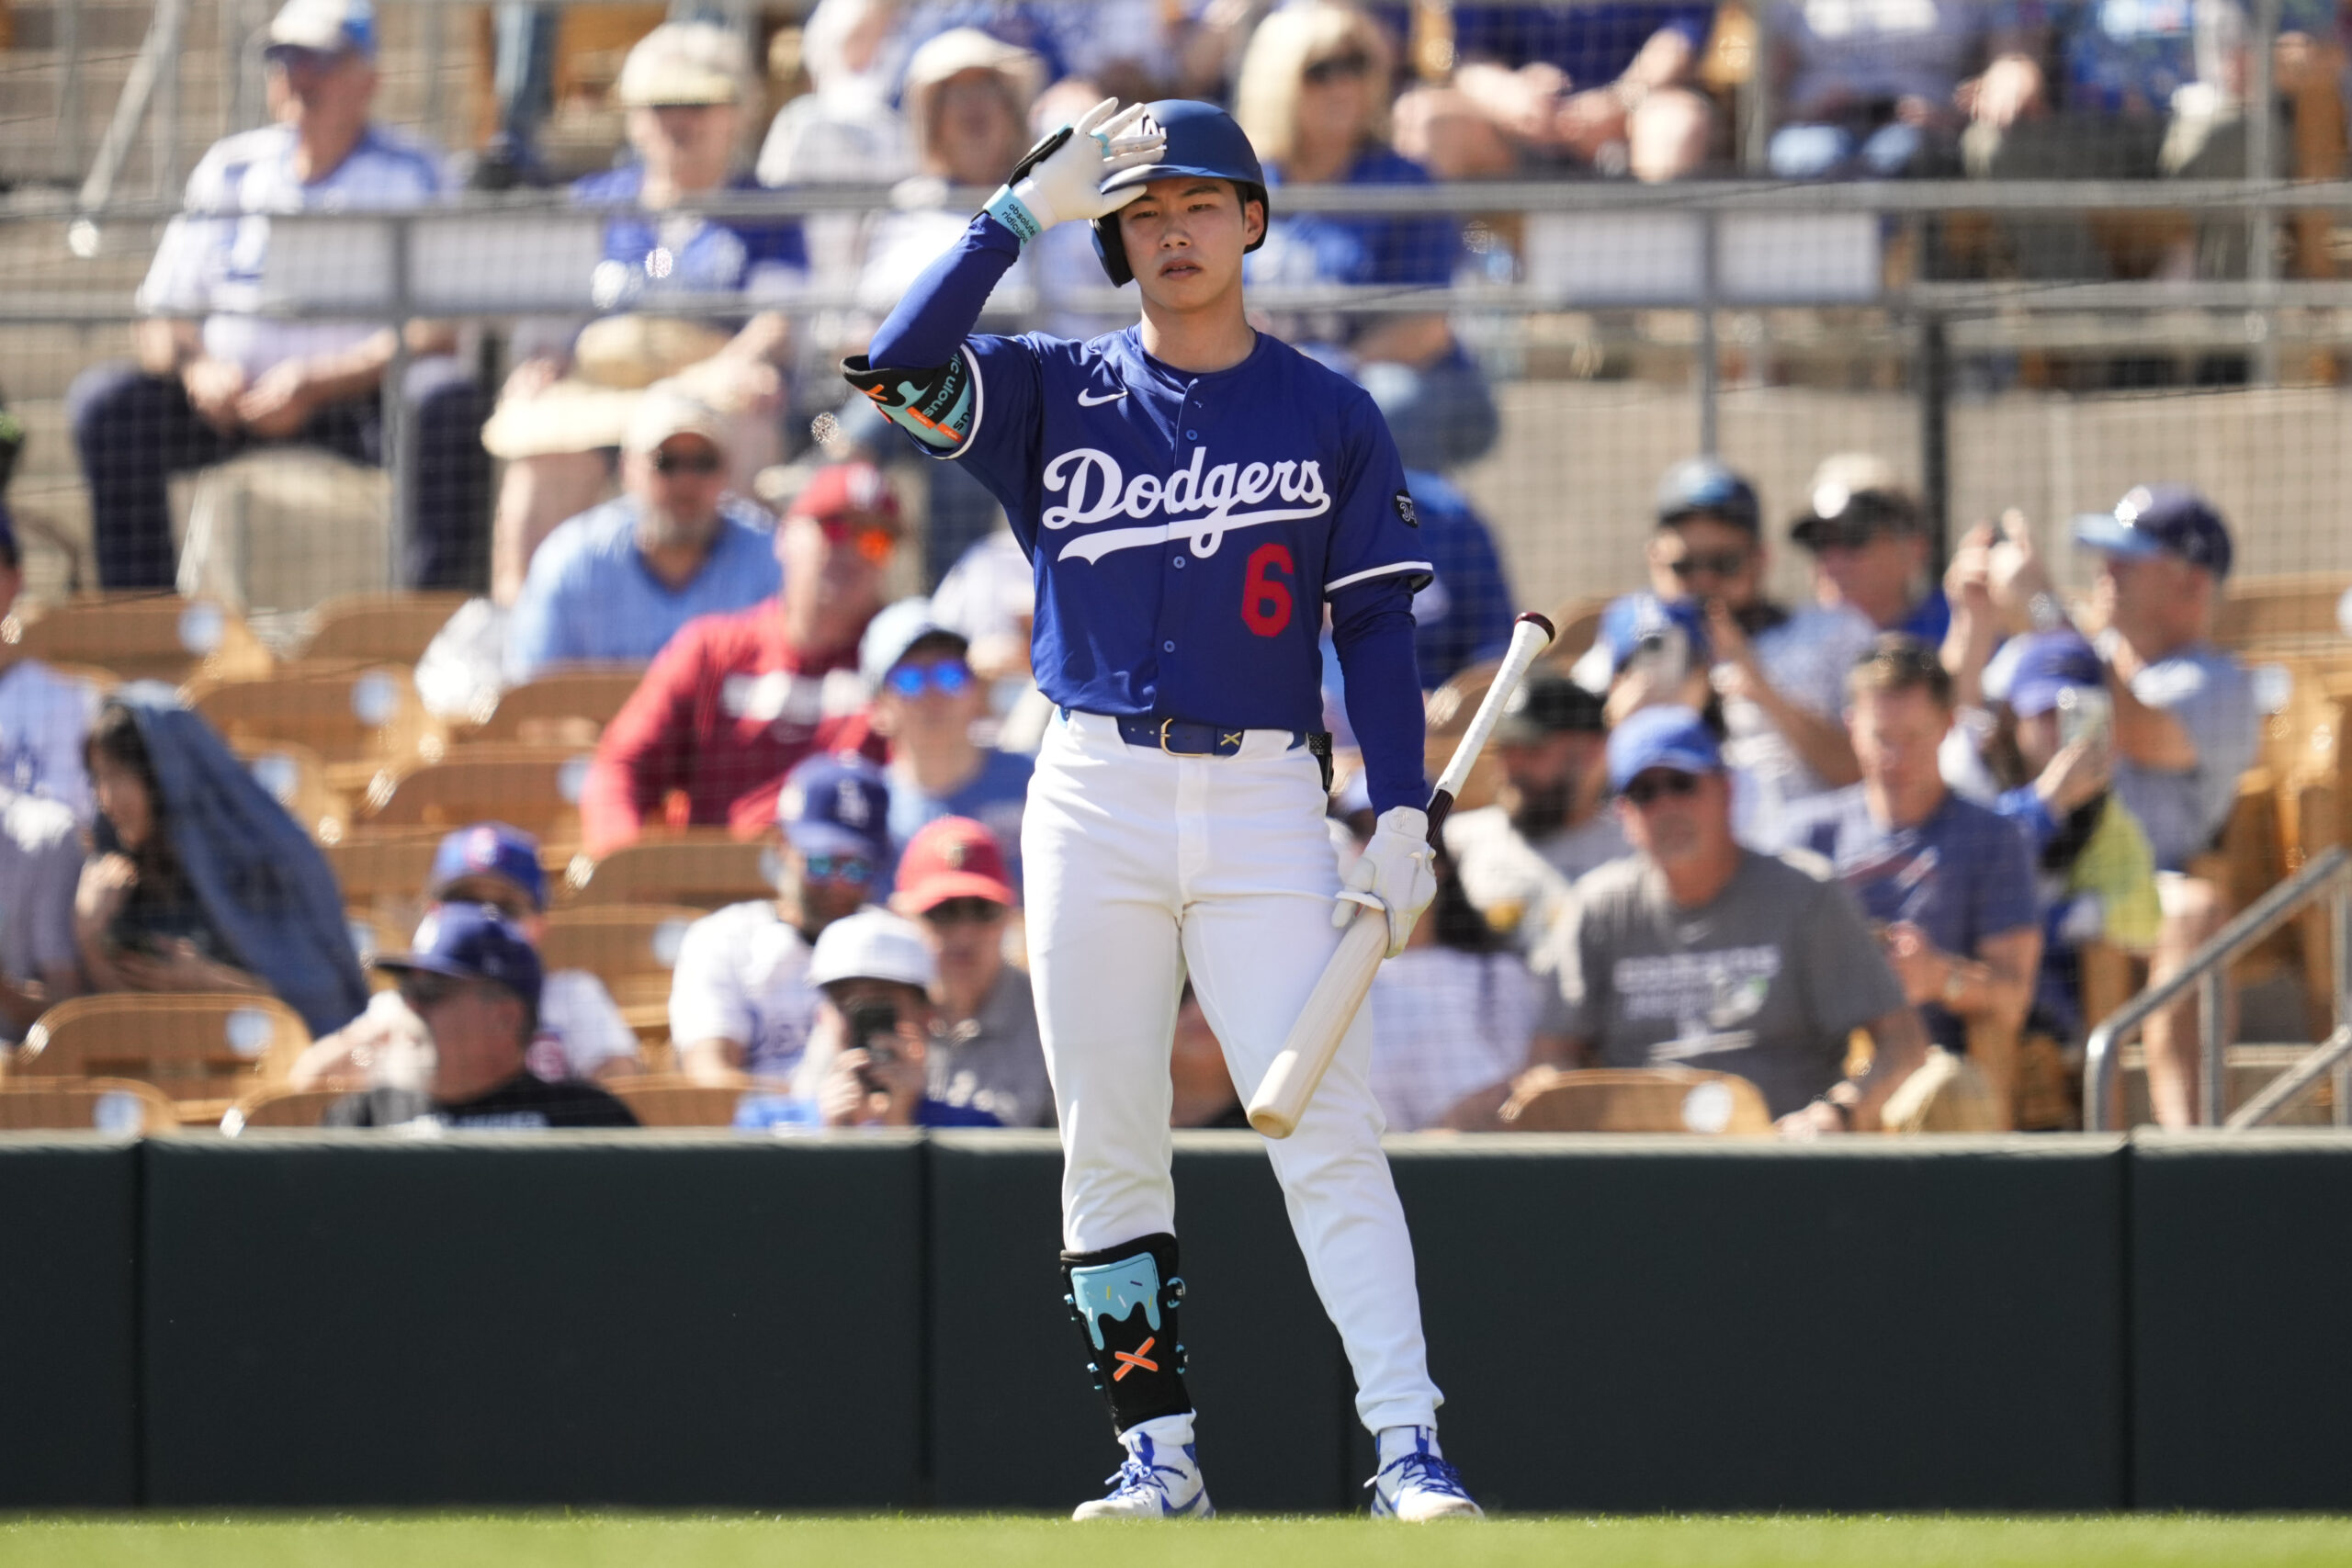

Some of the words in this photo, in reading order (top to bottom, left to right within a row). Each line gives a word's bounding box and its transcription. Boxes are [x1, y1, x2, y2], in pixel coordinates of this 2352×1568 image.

[1008, 203, 1036, 236] absolute
[1042, 446, 1331, 565] Dodgers
[1399, 502, 1417, 524] 34
[1241, 542, 1295, 637] 6
